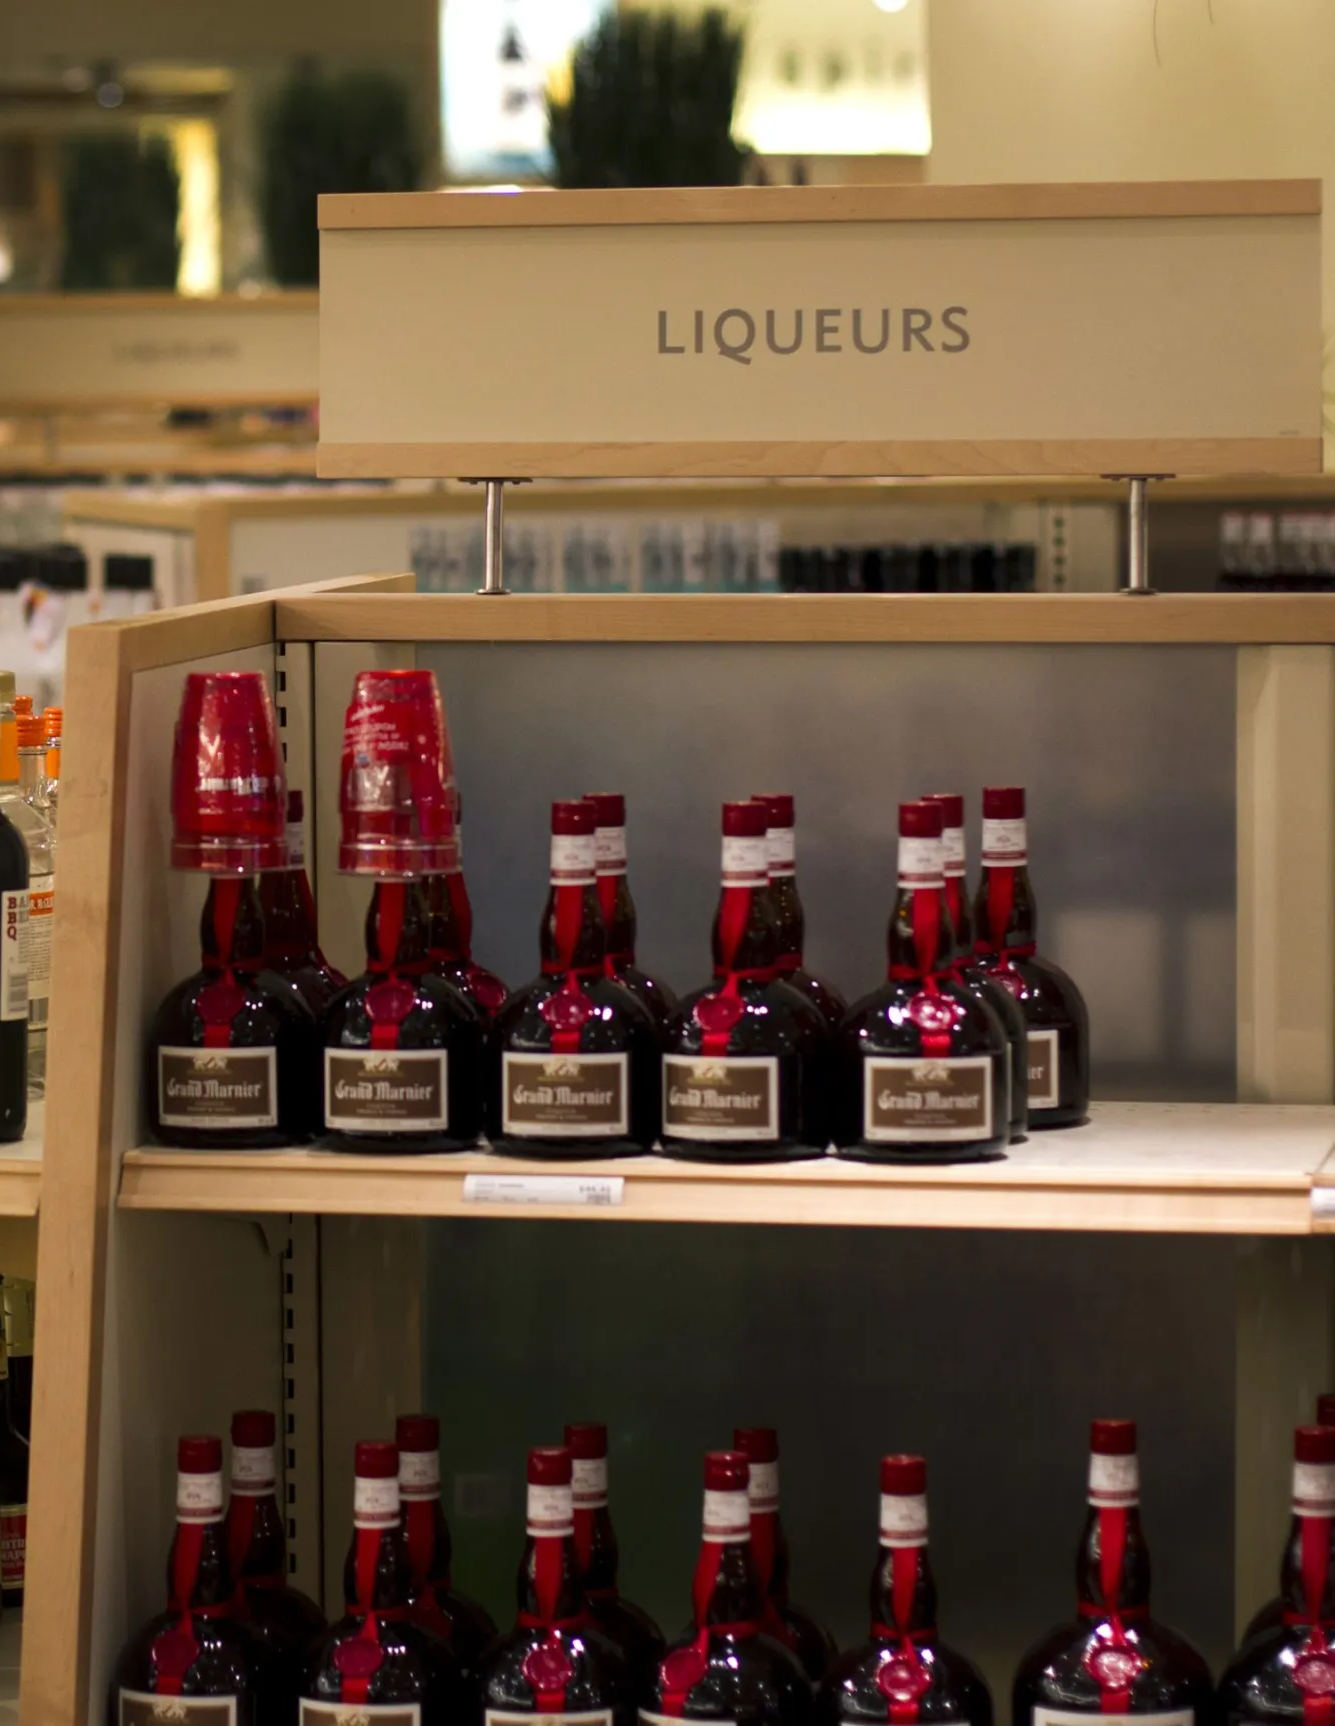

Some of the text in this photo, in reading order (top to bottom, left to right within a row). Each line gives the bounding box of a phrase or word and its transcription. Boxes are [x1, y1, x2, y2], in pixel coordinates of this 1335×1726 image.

[657, 306, 971, 366] LIQUEURS
[166, 1078, 263, 1099] Grand Marnier
[335, 1079, 434, 1101] Grand Marnier
[513, 1084, 614, 1106] Grand Marnier
[669, 1085, 762, 1110] Grand Marnier
[877, 1089, 981, 1111] Grand Marnier
